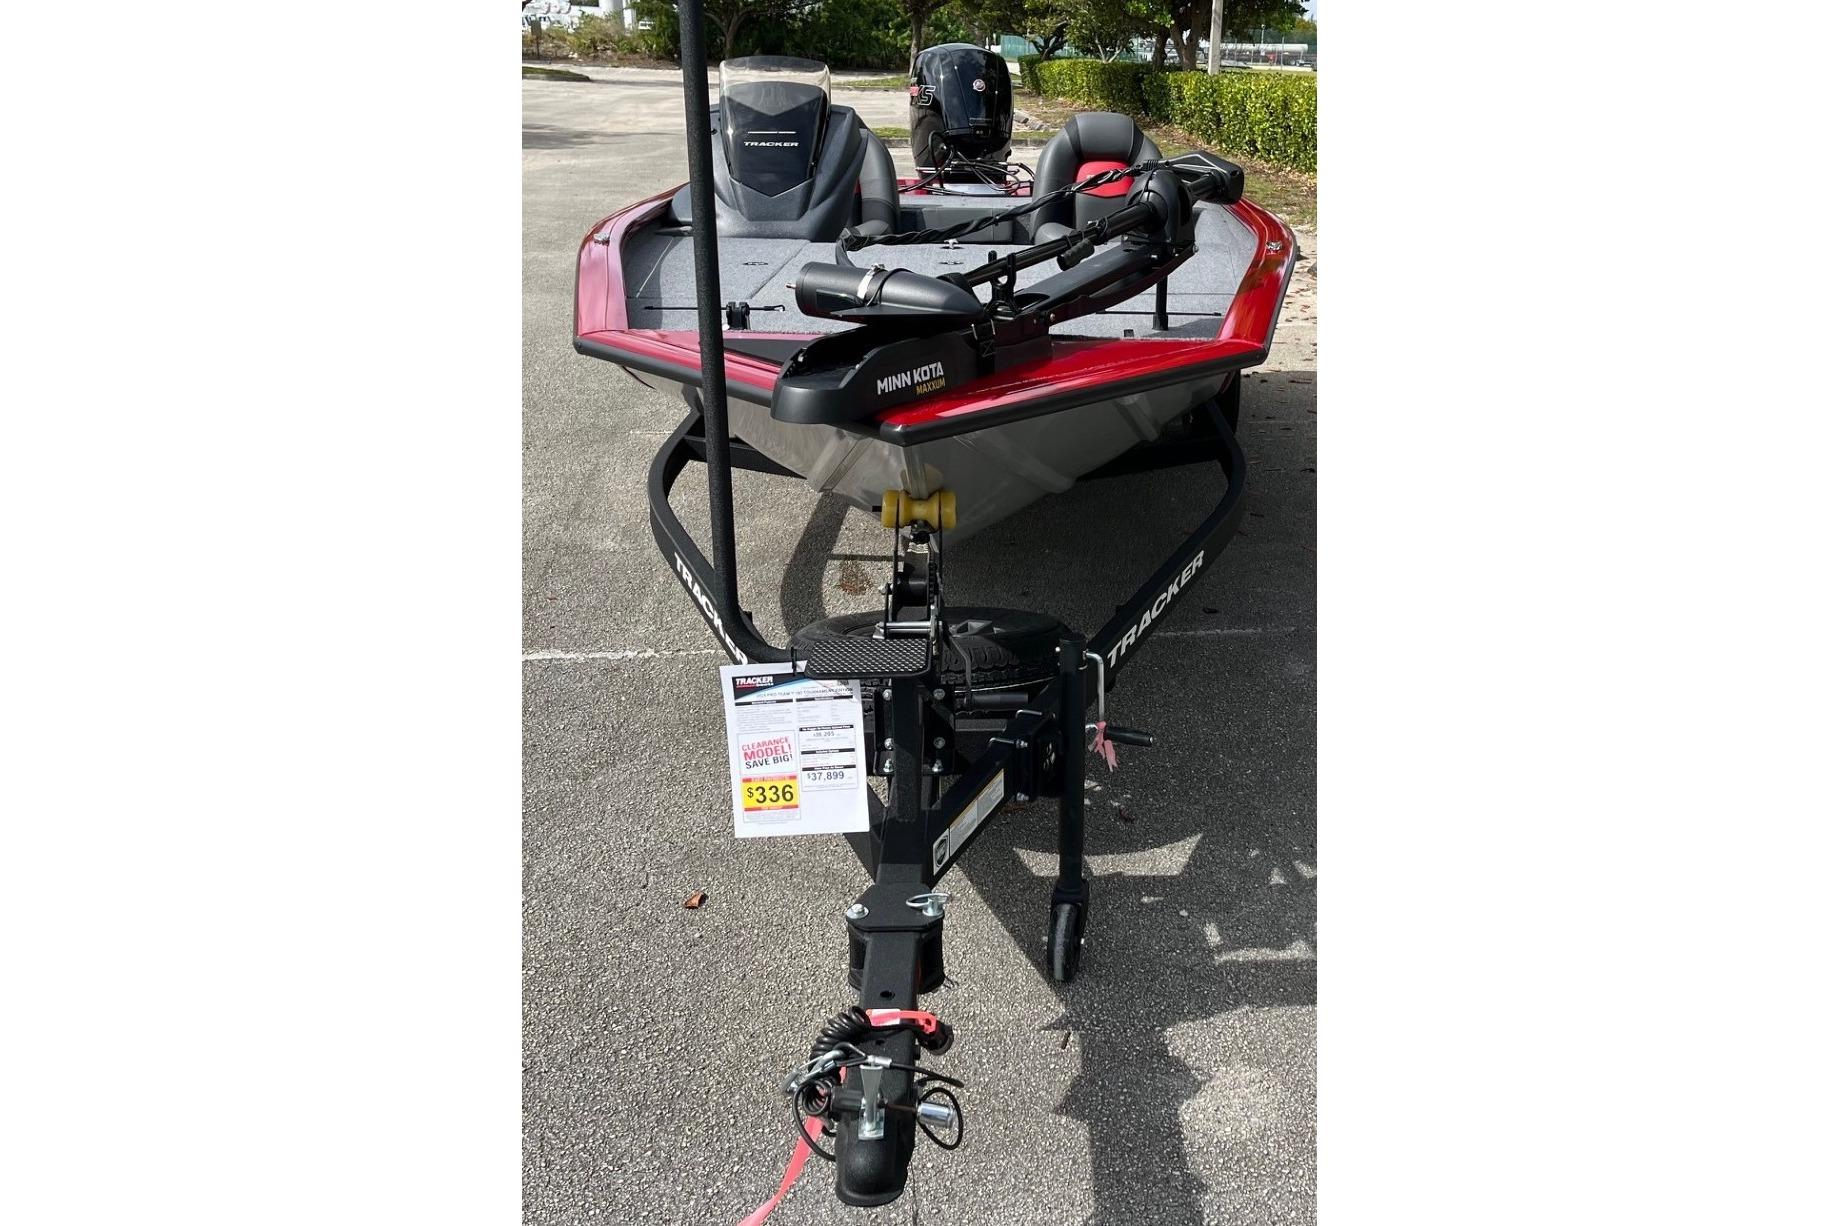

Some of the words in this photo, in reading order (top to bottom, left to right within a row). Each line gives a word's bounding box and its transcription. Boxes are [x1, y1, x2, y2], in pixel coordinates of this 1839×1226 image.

[877, 371, 912, 395] MINN
[912, 361, 944, 384] KOTA
[915, 377, 946, 395] MAXXUM
[1107, 550, 1205, 669] TRACKER
[735, 676, 774, 686] TRACKER
[742, 736, 789, 751] CLEARANCE
[744, 744, 792, 761] MODEL!
[745, 759, 770, 769] SAVE
[773, 754, 793, 764] BIG!
[807, 771, 845, 781] $37,899
[747, 784, 794, 804] $336
